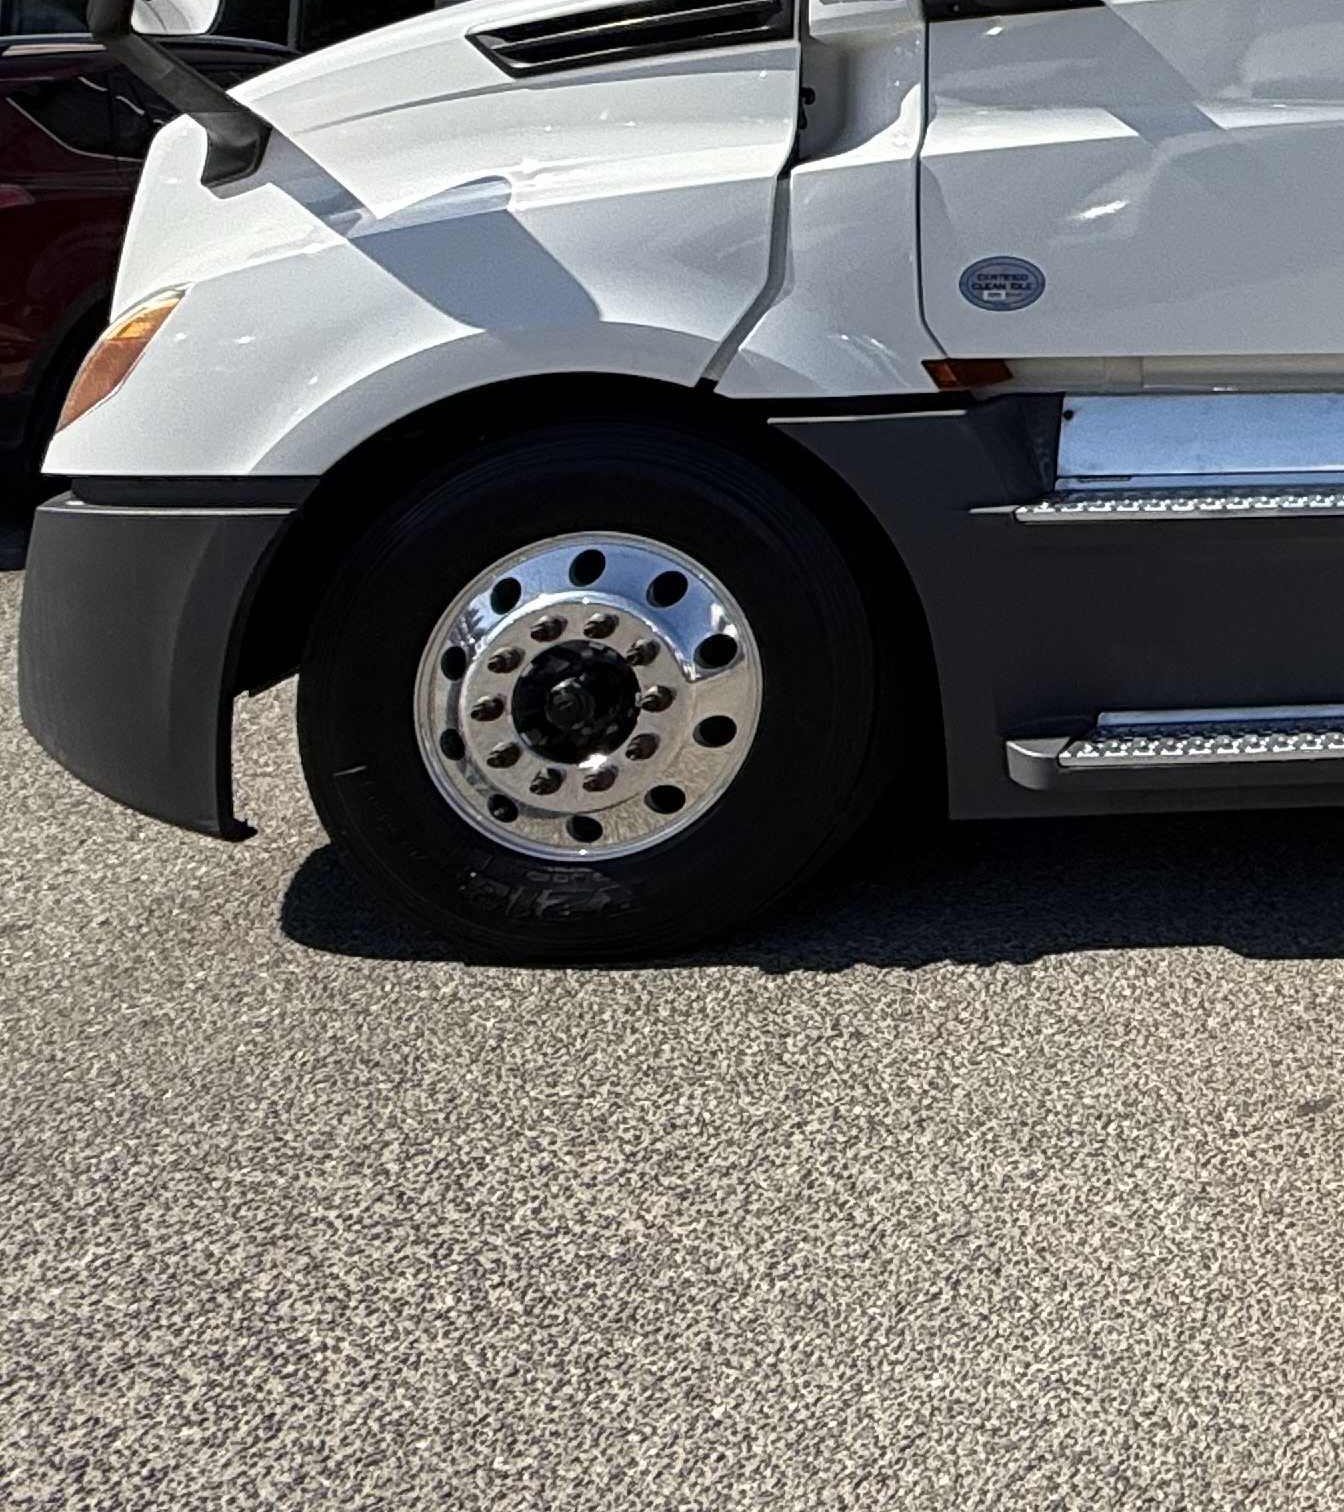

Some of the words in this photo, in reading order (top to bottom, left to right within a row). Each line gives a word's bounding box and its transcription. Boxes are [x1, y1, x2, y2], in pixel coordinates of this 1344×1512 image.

[976, 273, 1029, 282] CERTIFIED
[971, 282, 1006, 290] CLEAN
[1010, 282, 1032, 290] IDLE
